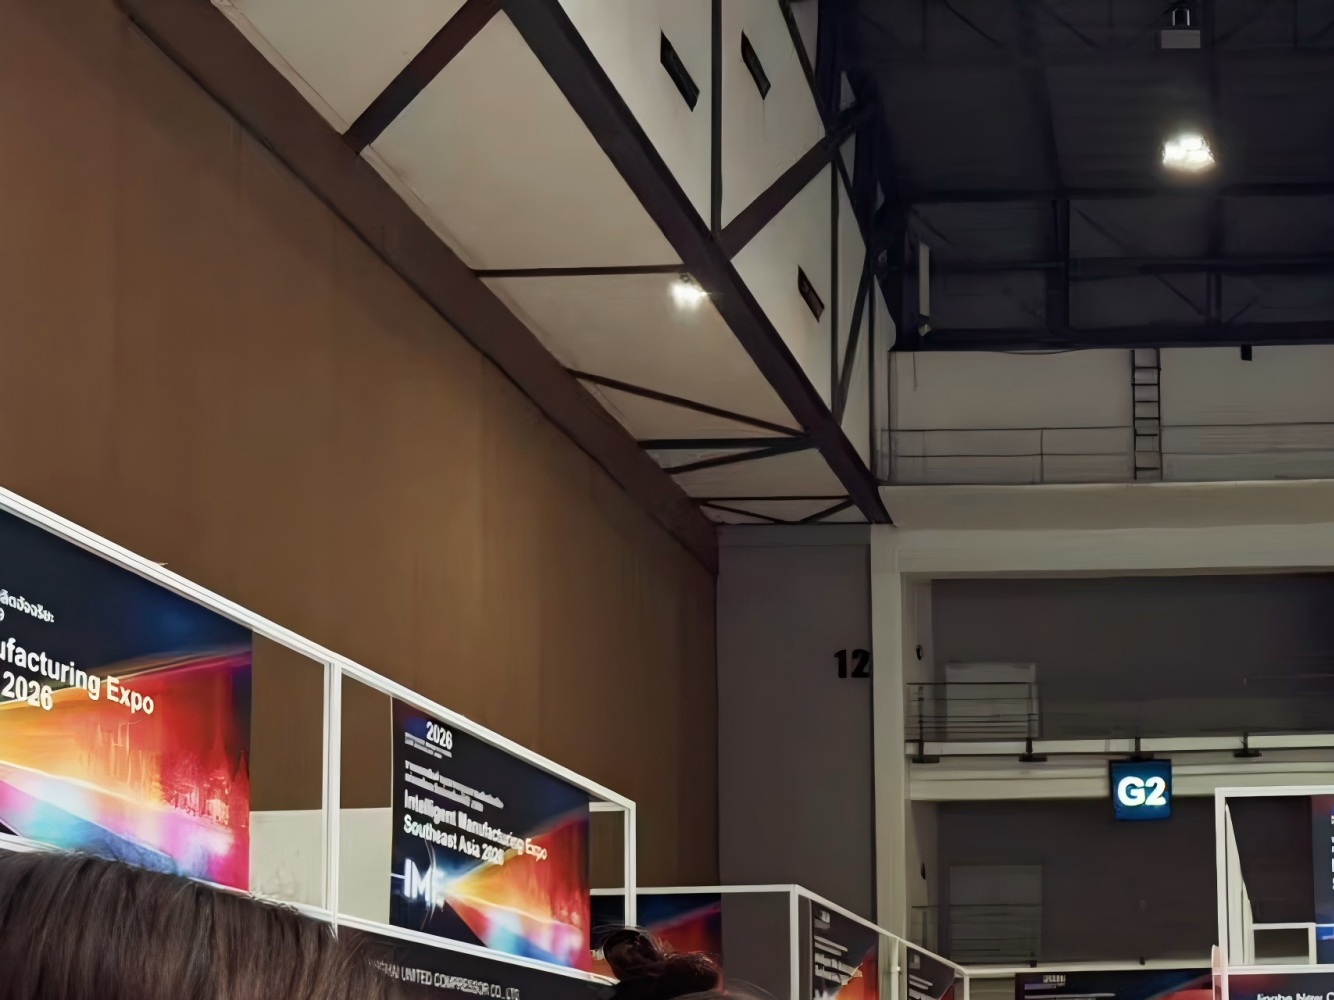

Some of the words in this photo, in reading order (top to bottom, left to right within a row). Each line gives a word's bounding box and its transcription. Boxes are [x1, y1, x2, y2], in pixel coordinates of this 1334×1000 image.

[833, 649, 870, 678] 12
[1, 671, 53, 711] 2026
[107, 675, 154, 715] Expo
[426, 721, 453, 750] 2026
[1117, 776, 1166, 806] G2
[401, 966, 433, 986] UNITED
